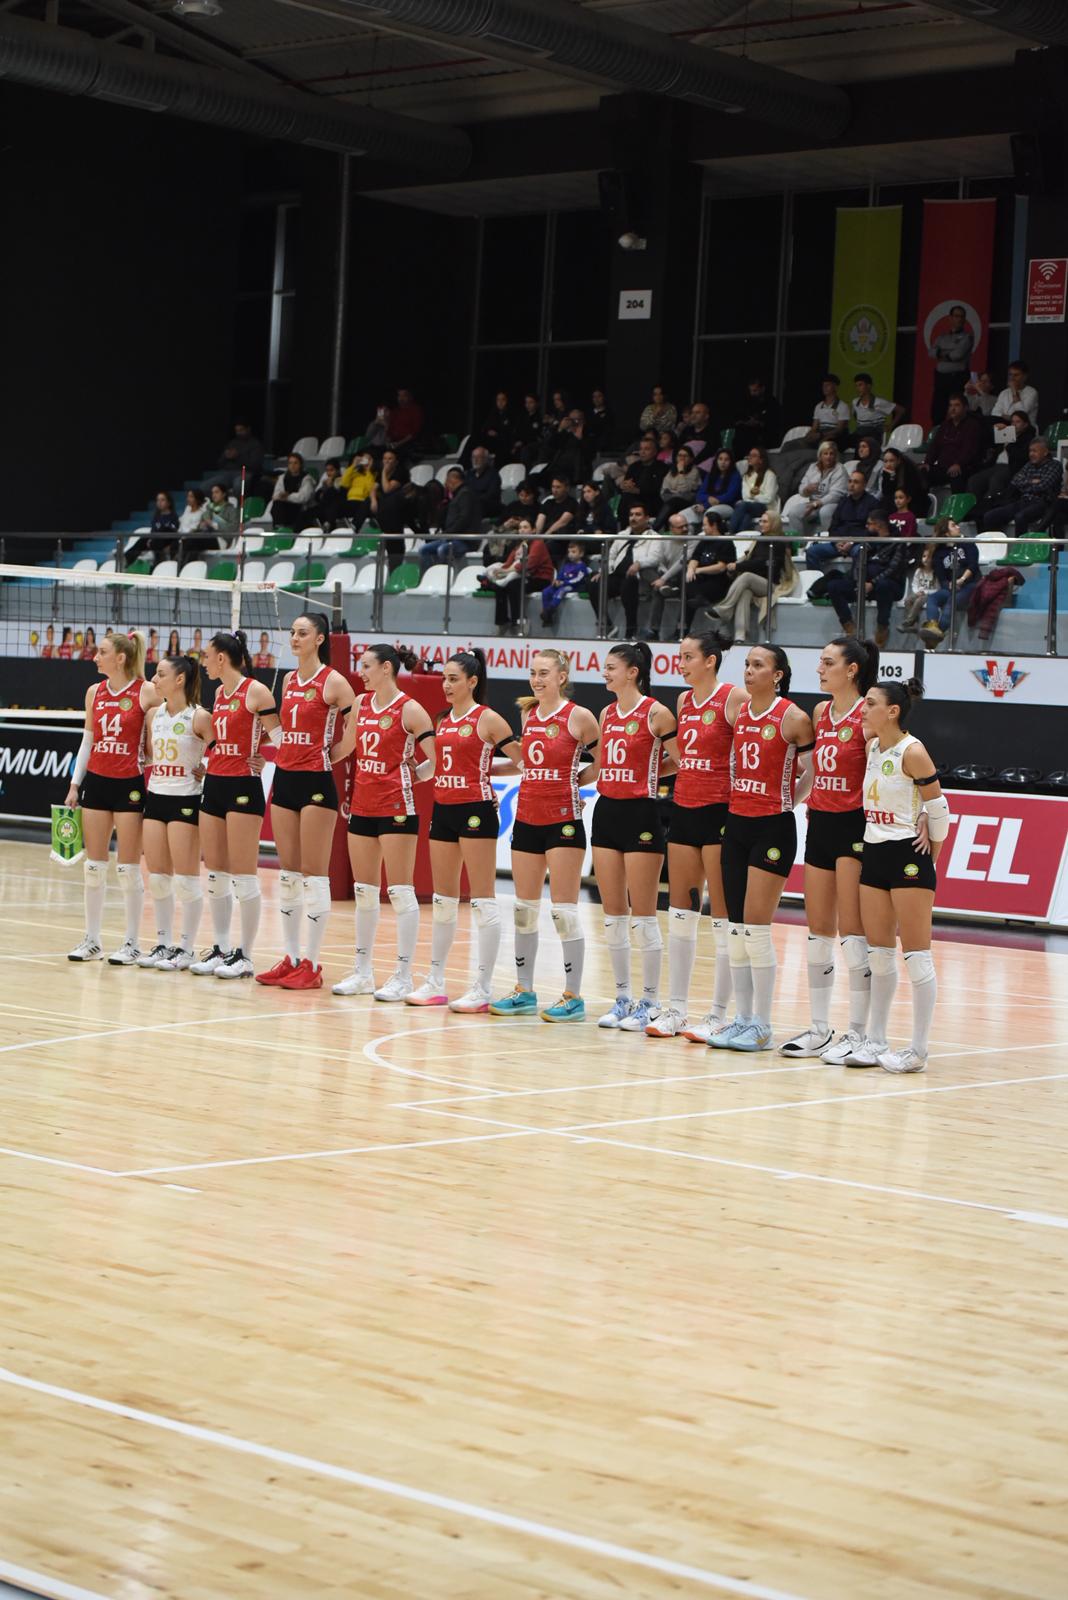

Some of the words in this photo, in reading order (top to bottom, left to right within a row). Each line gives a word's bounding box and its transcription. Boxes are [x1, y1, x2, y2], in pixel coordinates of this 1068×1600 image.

[626, 299, 644, 309] 204
[879, 665, 903, 678] 103
[98, 713, 122, 737] 14
[214, 716, 228, 740] 11
[289, 704, 299, 729] 1
[154, 738, 179, 762] 35
[281, 731, 314, 745] ESTEL
[359, 731, 380, 758] 12
[683, 728, 698, 755] 2
[442, 746, 453, 772] 5
[528, 740, 545, 765] 6
[605, 738, 627, 765] 16
[739, 742, 760, 770] 13
[816, 744, 838, 772] 18
[783, 757, 792, 782] AGENCY
[867, 779, 880, 807] 4
